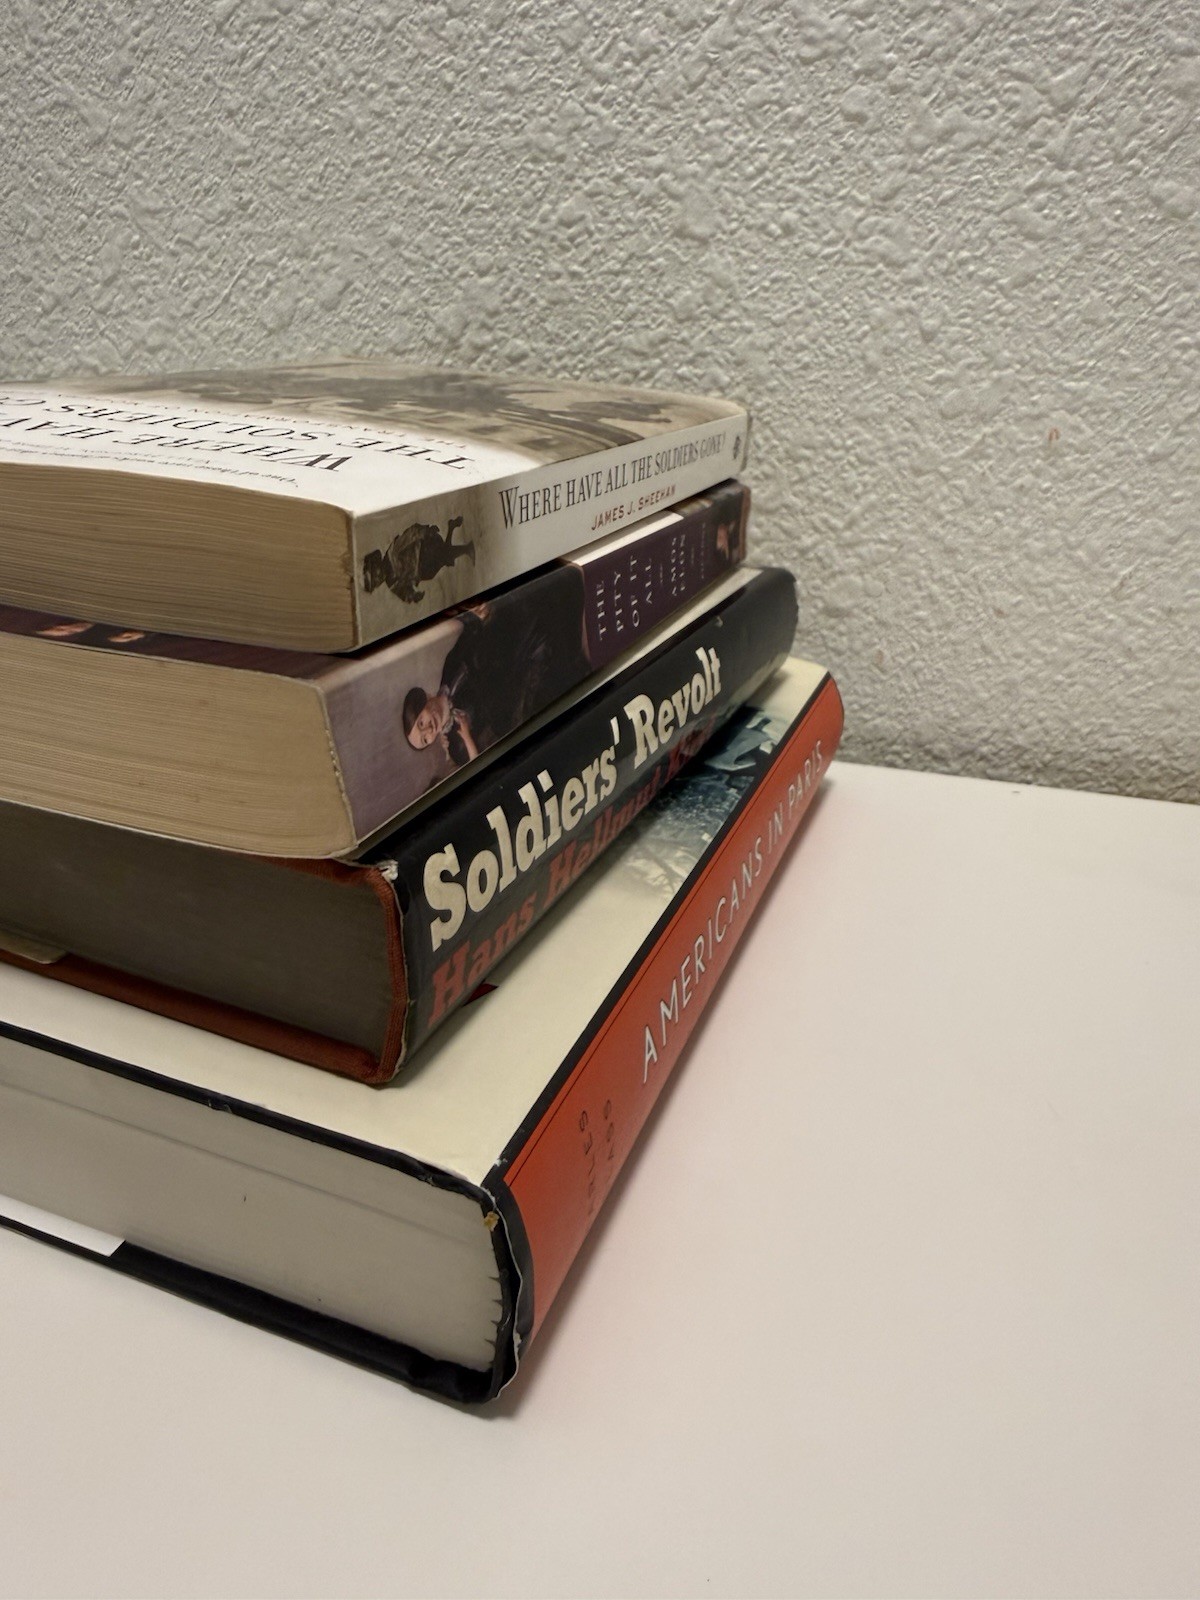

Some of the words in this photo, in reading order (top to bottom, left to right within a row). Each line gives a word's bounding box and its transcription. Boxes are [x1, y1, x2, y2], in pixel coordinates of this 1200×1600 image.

[0, 412, 124, 439] HAV
[42, 404, 335, 441] SOLDIERS
[112, 434, 353, 472] WHERE
[336, 437, 475, 470] THE
[498, 483, 562, 530] WHERE
[565, 470, 602, 508] HAVE
[604, 462, 629, 494] ALL
[631, 454, 653, 484] THE
[654, 440, 699, 476] SOLDIERS
[591, 504, 624, 531] JAMES
[626, 501, 636, 516] J.
[638, 484, 676, 511] SHEEHAN
[629, 554, 637, 581] IT
[645, 558, 653, 604] ALL
[596, 580, 607, 641] THE
[614, 571, 624, 632] PITY
[631, 595, 640, 628] OF
[624, 646, 721, 769] Revolt
[642, 836, 763, 1084] AMERICANS
[767, 801, 784, 854] IN
[788, 739, 823, 820] PARIS
[427, 889, 538, 1029] Hans
